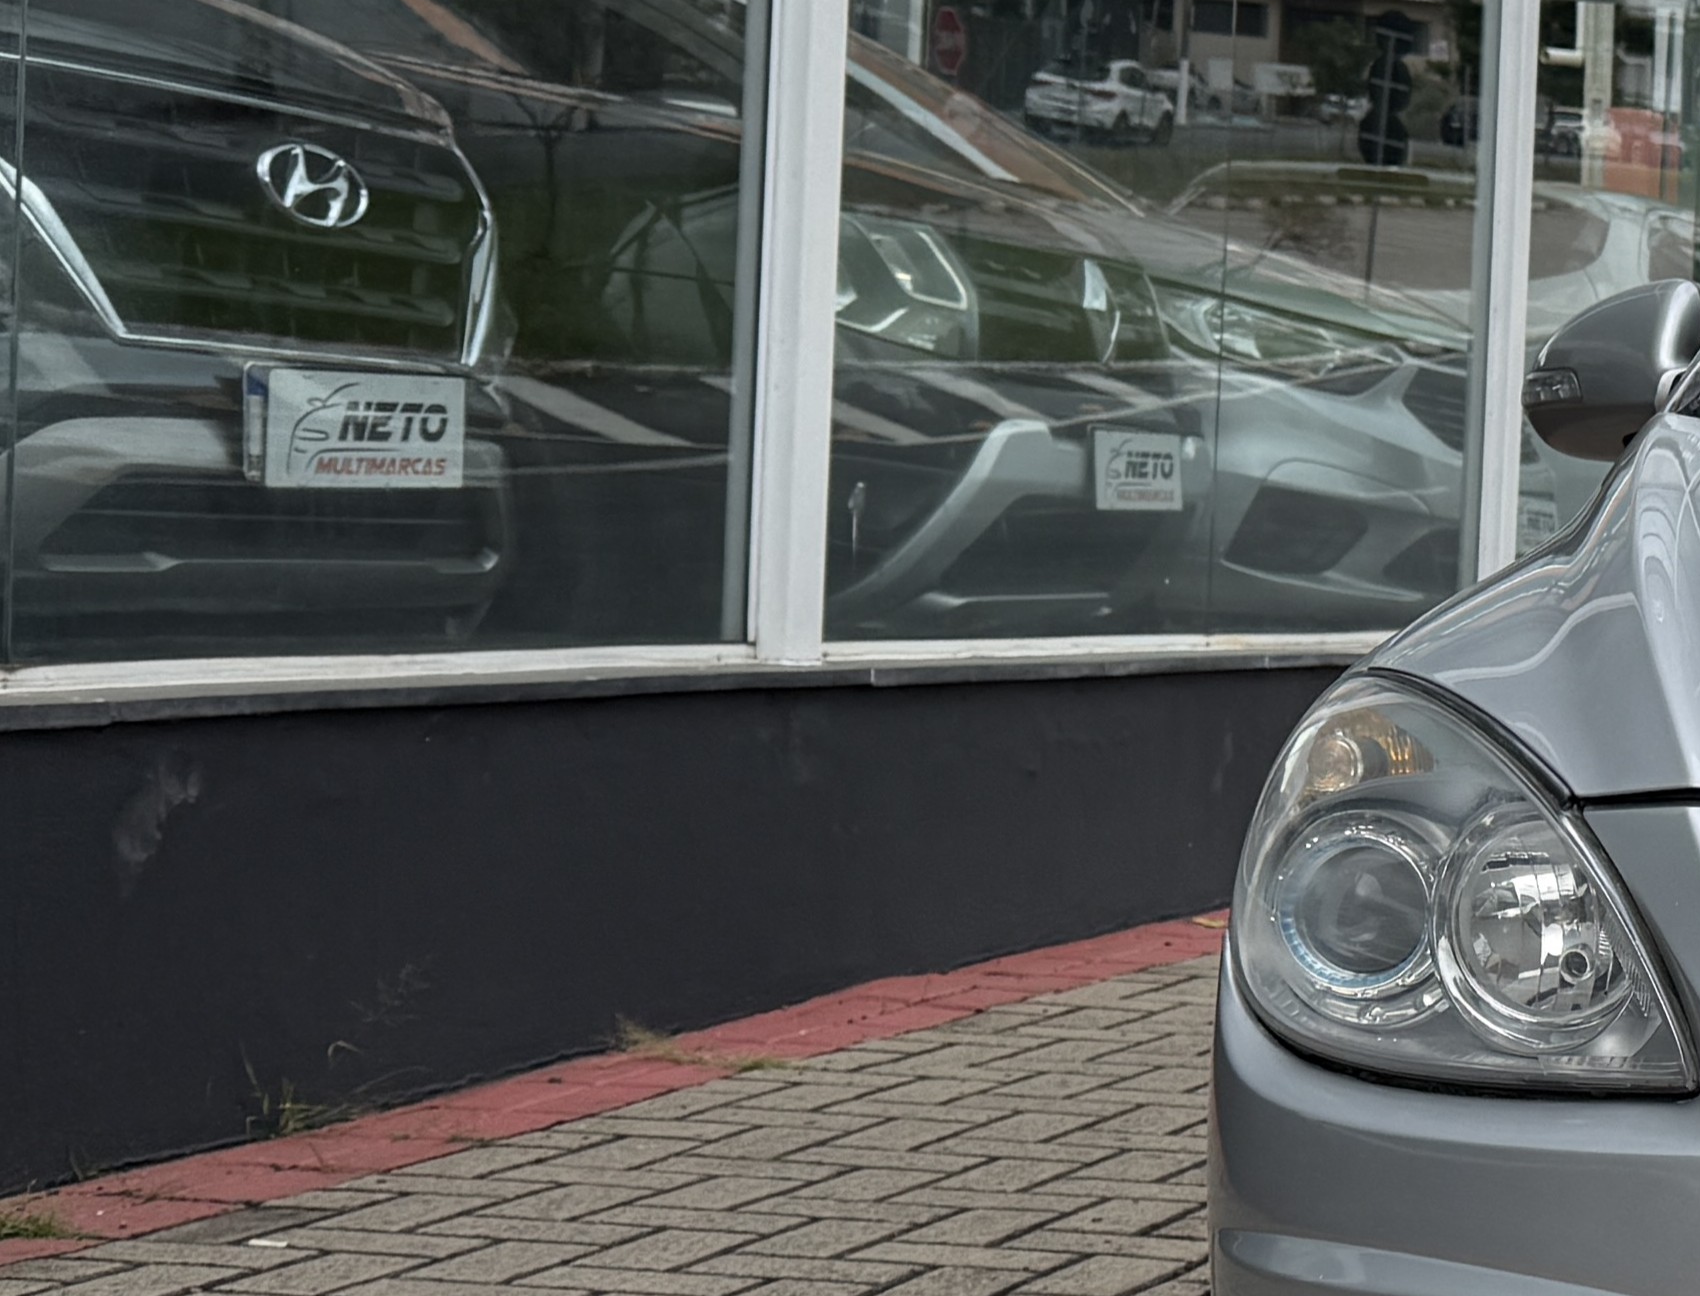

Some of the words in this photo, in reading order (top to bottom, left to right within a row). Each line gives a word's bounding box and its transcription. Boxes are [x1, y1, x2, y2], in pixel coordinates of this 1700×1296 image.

[338, 400, 448, 443] NETO
[315, 456, 448, 476] MULTIMARCAS
[1125, 450, 1174, 480] NETO
